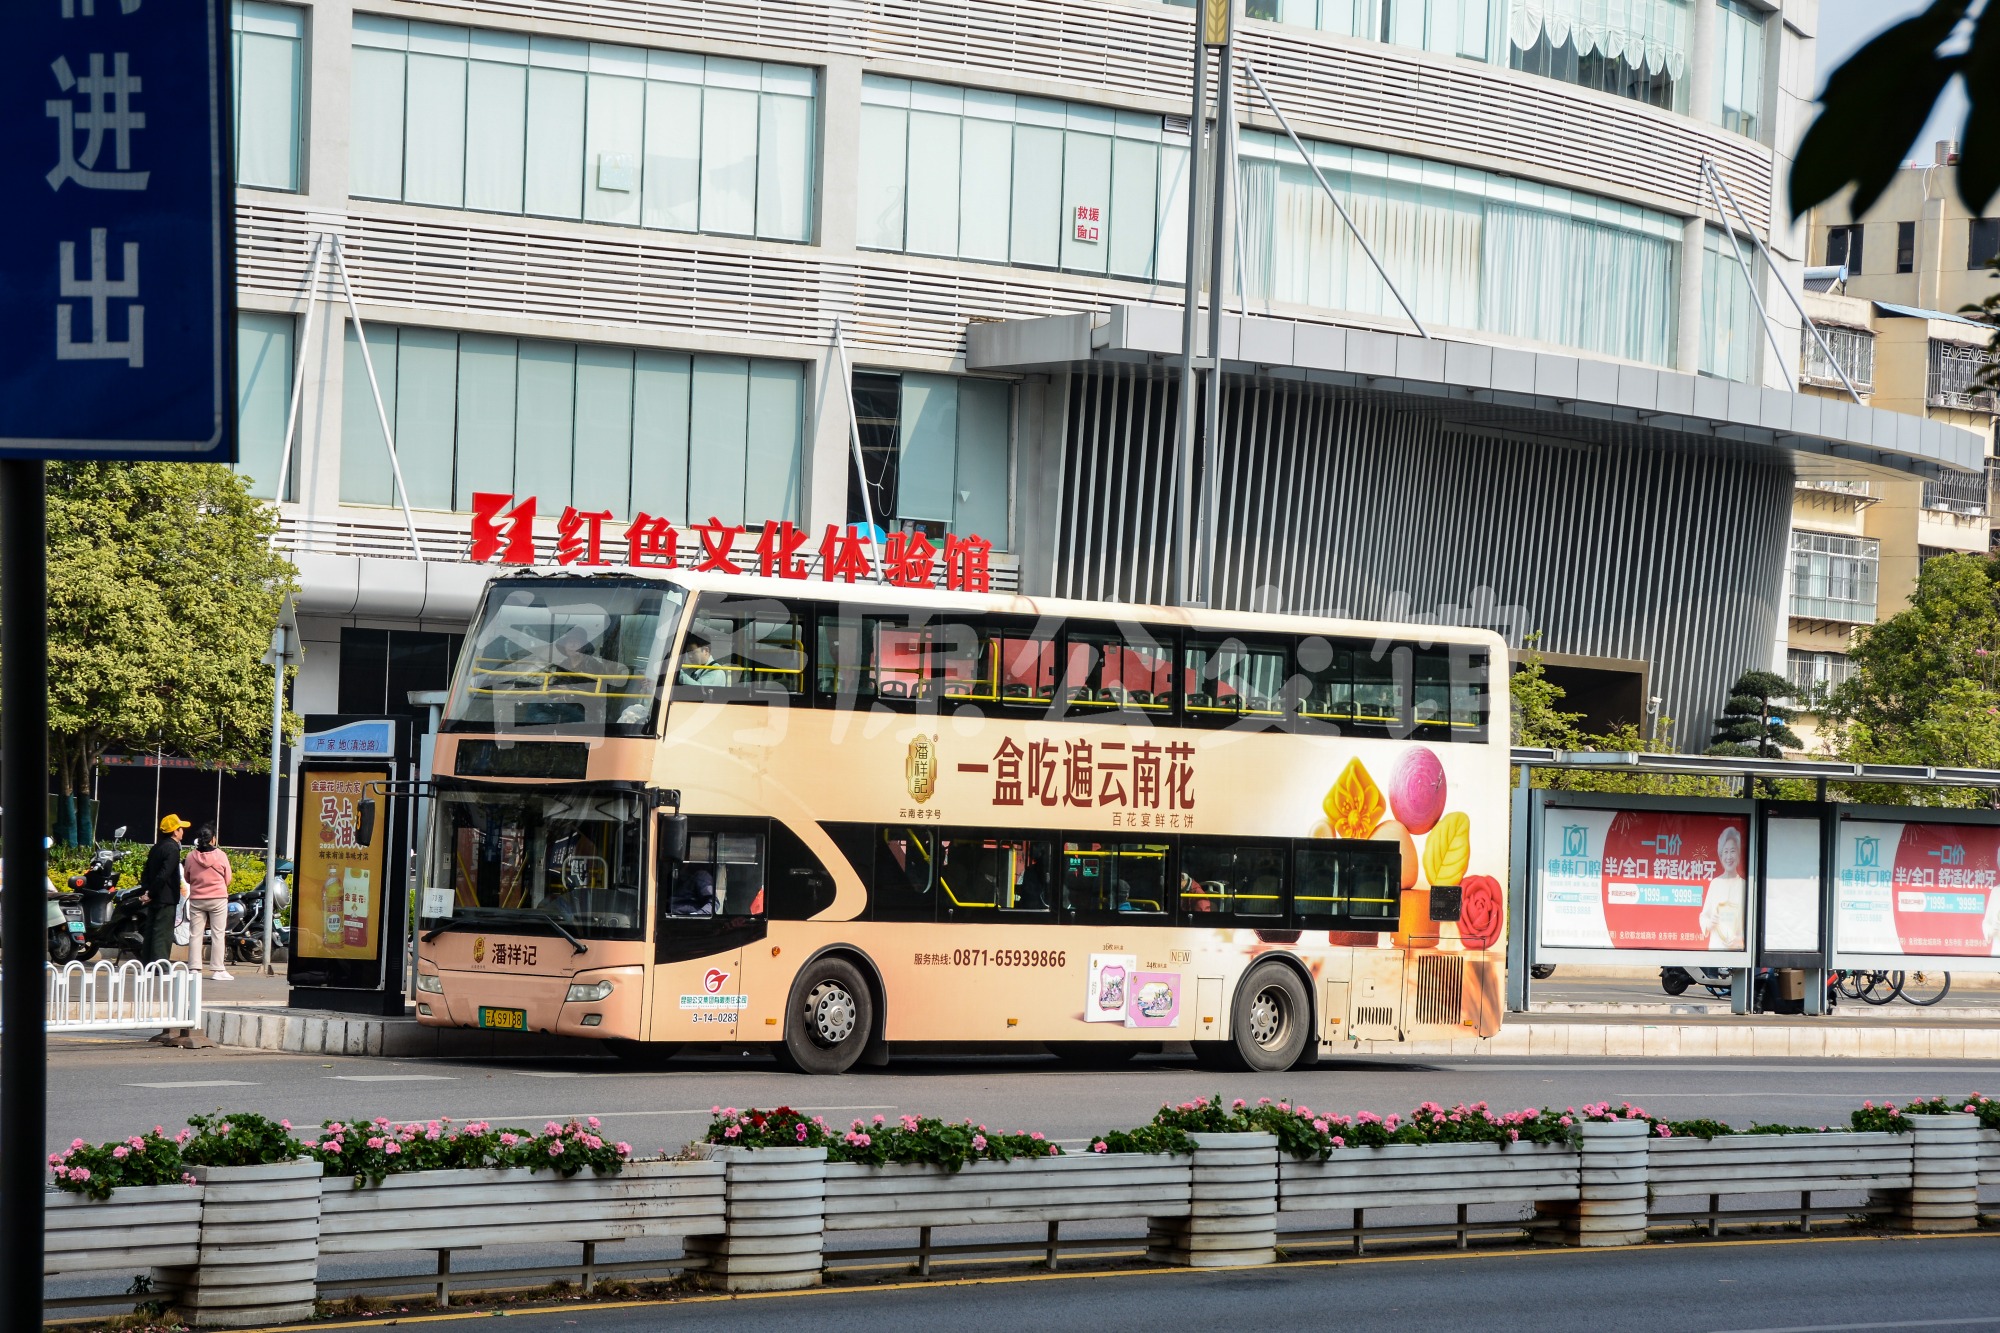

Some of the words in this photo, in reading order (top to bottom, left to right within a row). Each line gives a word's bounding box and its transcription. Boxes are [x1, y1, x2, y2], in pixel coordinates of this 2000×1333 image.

[45, 0, 150, 368] 进出
[1077, 206, 1099, 221] 救援
[1077, 225, 1099, 240] 窗口
[556, 505, 992, 594] 红色文化体验馆
[957, 736, 1195, 810] 一盒吃遍云南花
[320, 796, 353, 827] 马上
[899, 808, 941, 820] 云南老字号
[1112, 812, 1194, 828] 百花宴鲜花饼
[1641, 834, 1682, 855] 一口价
[1928, 845, 1966, 865] 一口价
[1548, 859, 1601, 880] 德韩口腔
[1605, 857, 1649, 878] 半/全口
[1653, 859, 1716, 881] 舒适化种牙
[1841, 869, 1891, 888] 德韩口腔
[1895, 867, 1934, 887] 半/全口
[1938, 868, 1996, 890] 舒适化种牙
[492, 943, 537, 966] 潘祥记
[953, 949, 1066, 967] 0871-65939866
[1171, 951, 1190, 962] NEW
[693, 1013, 738, 1022] 3-14-0283
